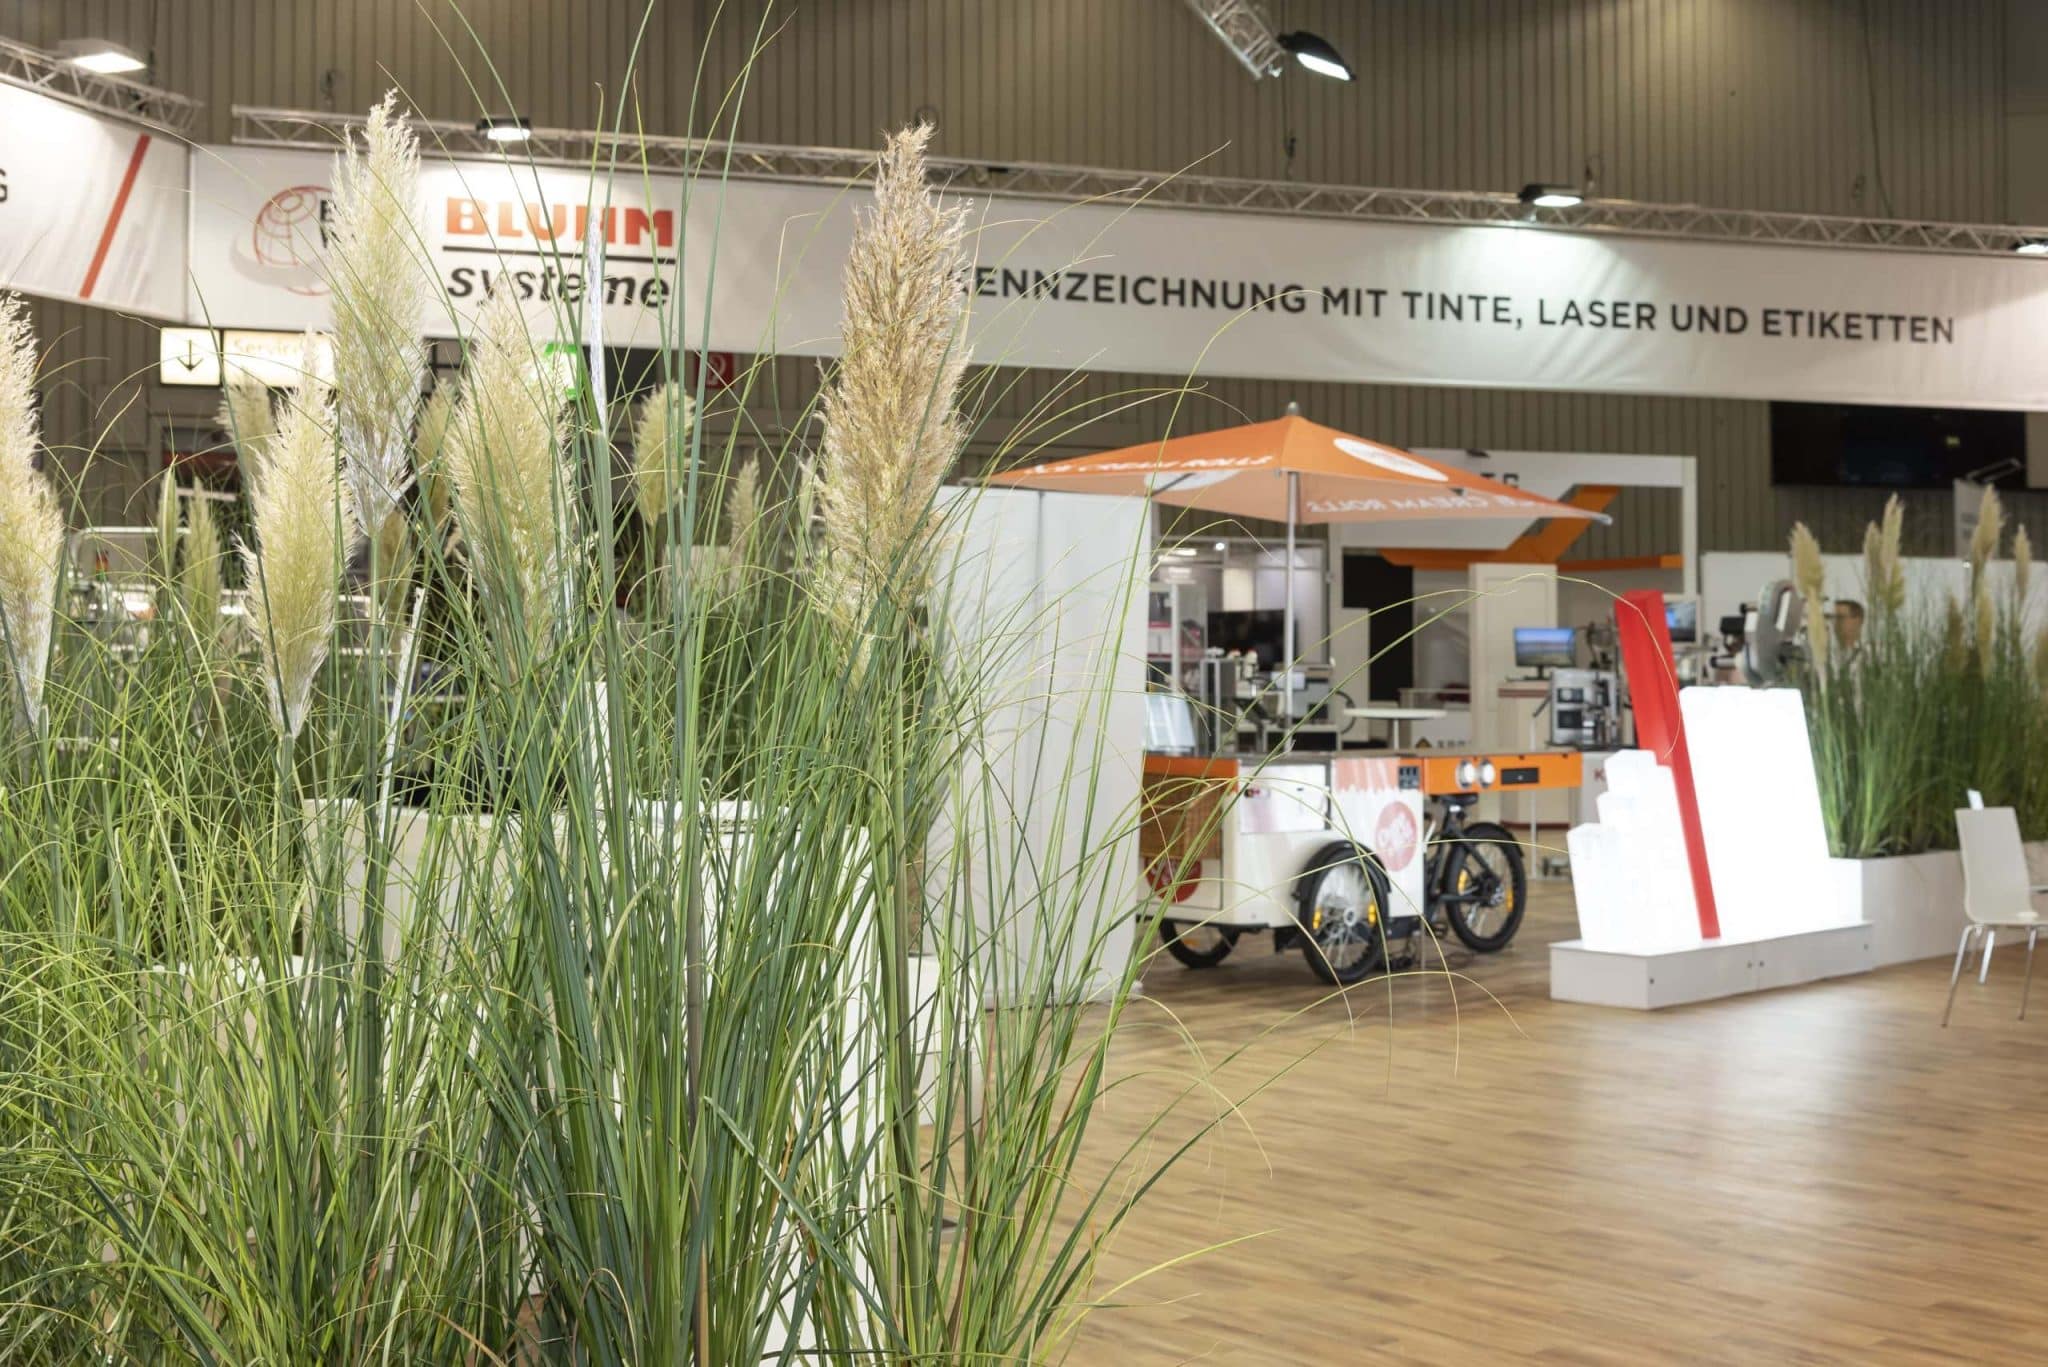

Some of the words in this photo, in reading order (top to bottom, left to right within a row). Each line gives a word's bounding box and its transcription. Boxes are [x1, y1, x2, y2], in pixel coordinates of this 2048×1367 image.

[1321, 285, 1388, 318] MIT
[1402, 290, 1523, 331] TINTE,
[1538, 297, 1657, 331] LASER
[1670, 303, 1749, 336] UND
[1761, 308, 1955, 345] ETIKETTEN
